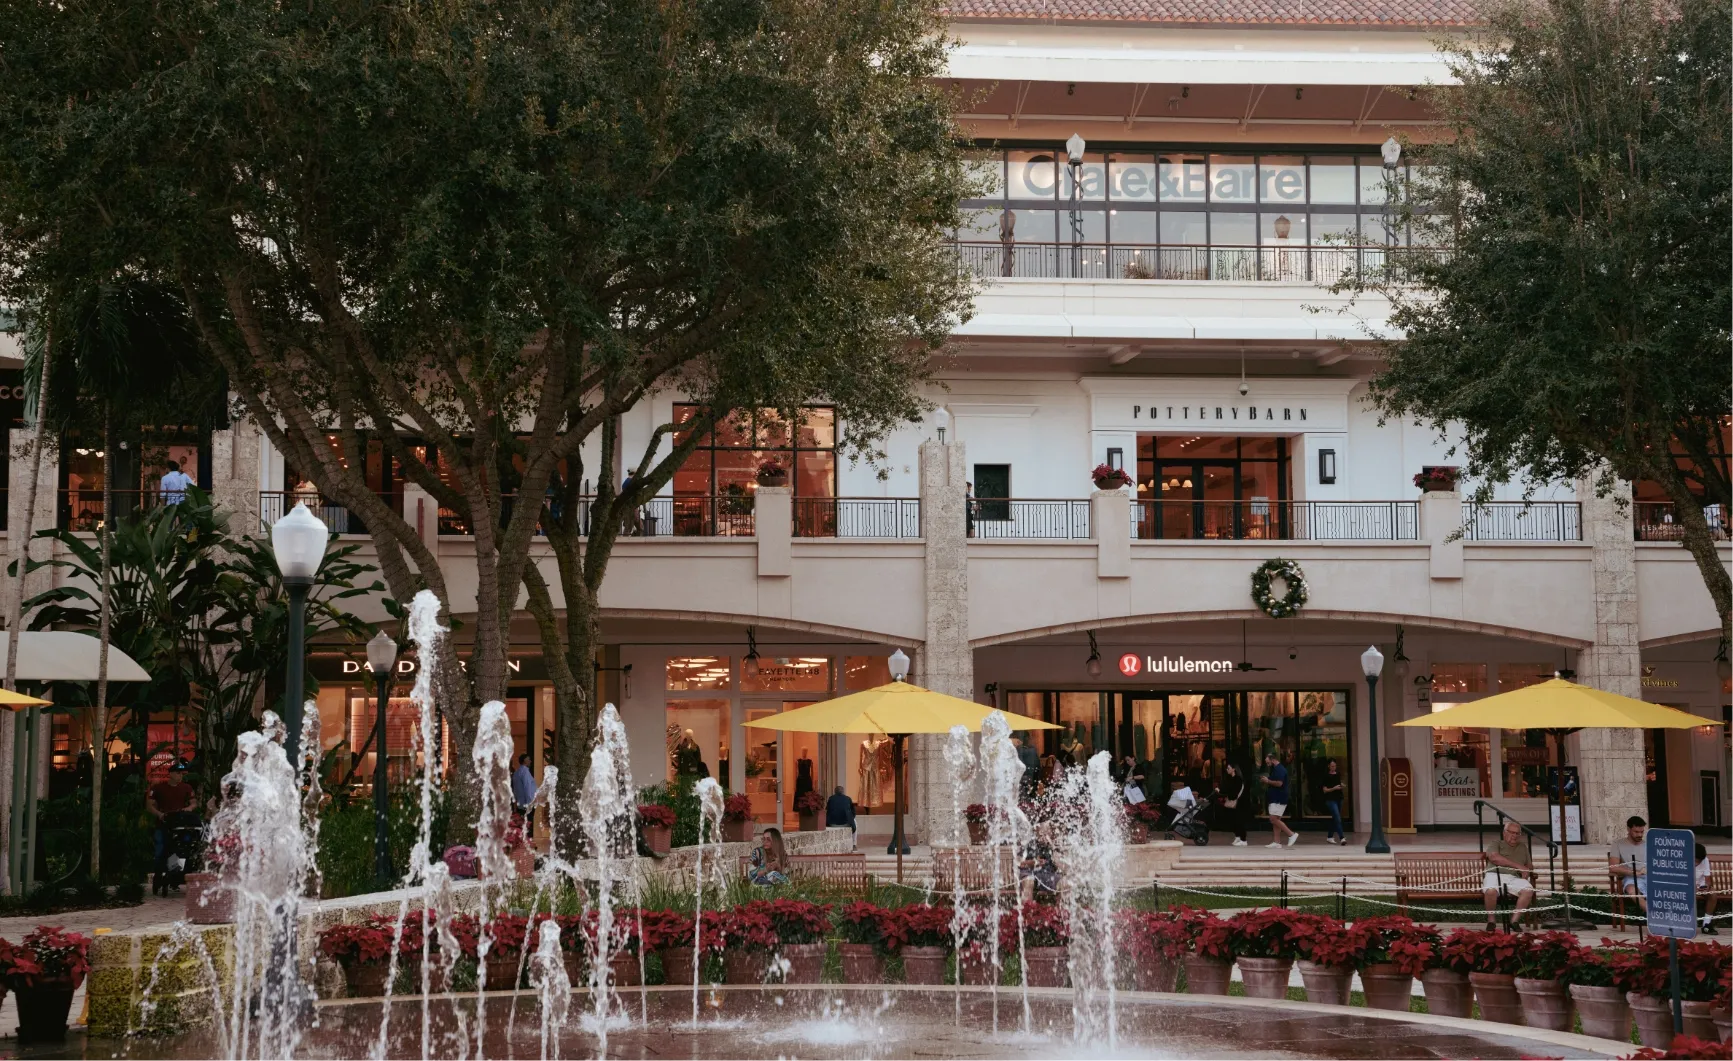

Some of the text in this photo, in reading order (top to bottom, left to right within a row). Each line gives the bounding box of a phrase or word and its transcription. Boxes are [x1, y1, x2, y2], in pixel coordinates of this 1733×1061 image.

[1147, 656, 1232, 673] lululemon
[1438, 787, 1476, 797] GREETINGS
[1654, 837, 1685, 847] FOUNTAIN
[1656, 849, 1684, 858] NOT FOR
[1652, 858, 1688, 870] PUBLIC USE
[1654, 890, 1687, 901] LA FUENTE
[1652, 900, 1689, 912] NO ES PARA
[1651, 911, 1692, 923] USO PÚBLICO
